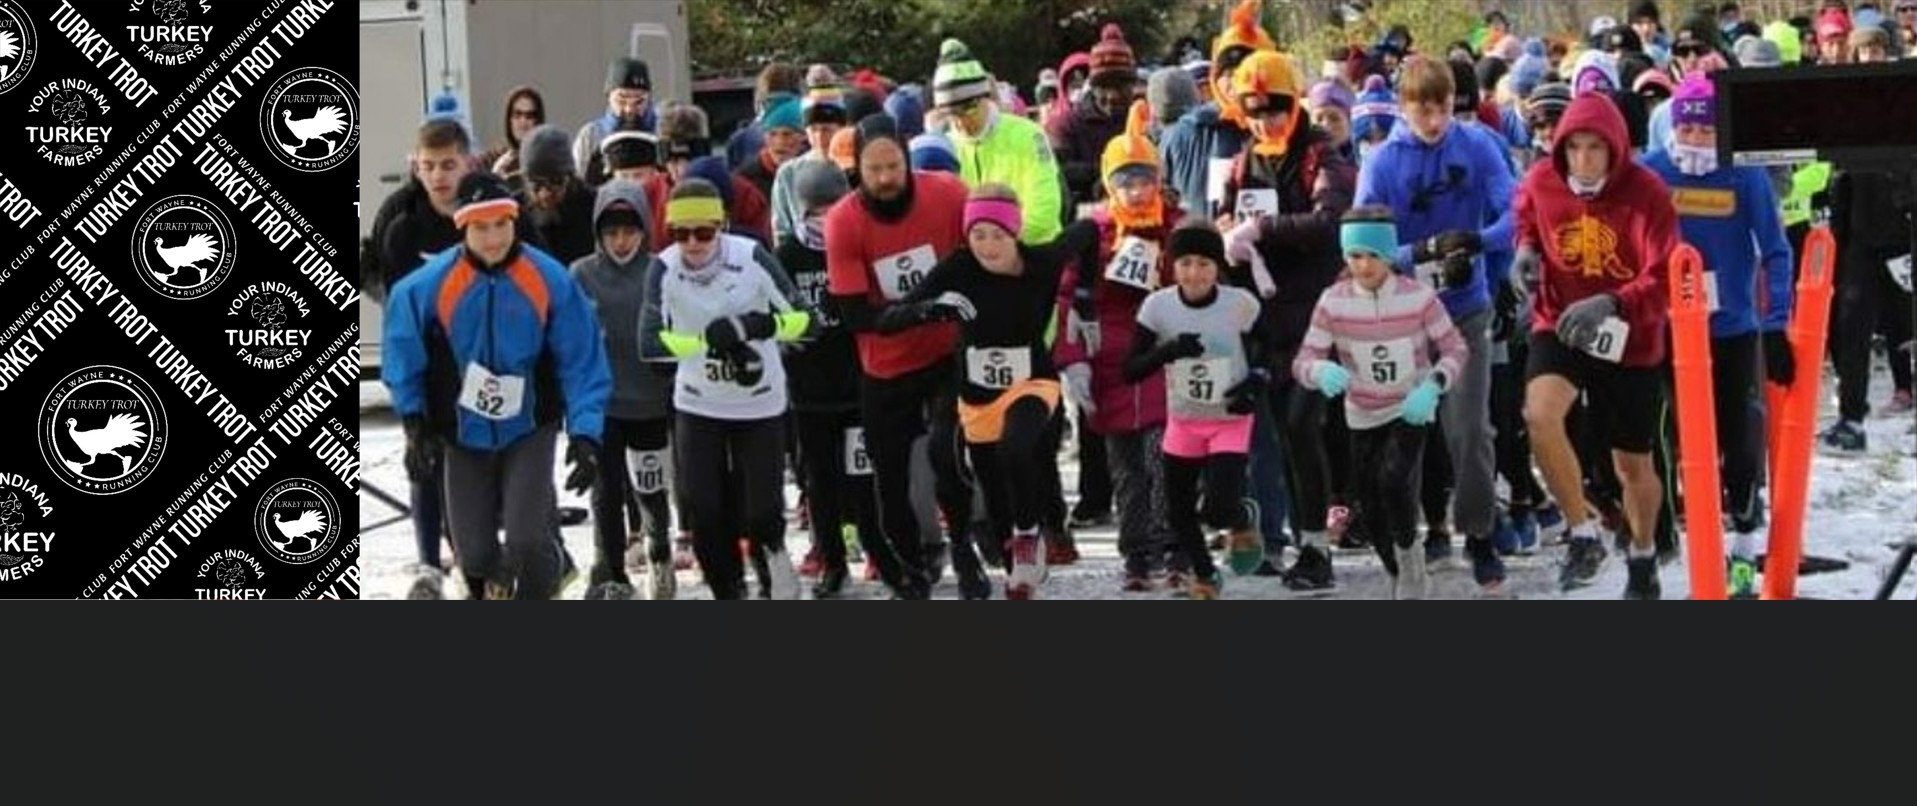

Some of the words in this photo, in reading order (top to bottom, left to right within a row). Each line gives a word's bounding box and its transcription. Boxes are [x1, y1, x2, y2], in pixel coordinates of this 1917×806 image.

[1116, 256, 1149, 284] 214
[983, 364, 1013, 387] 36
[1371, 361, 1396, 384] 57
[1189, 379, 1214, 401] 37
[477, 389, 504, 417] 52
[636, 469, 664, 491] 101
